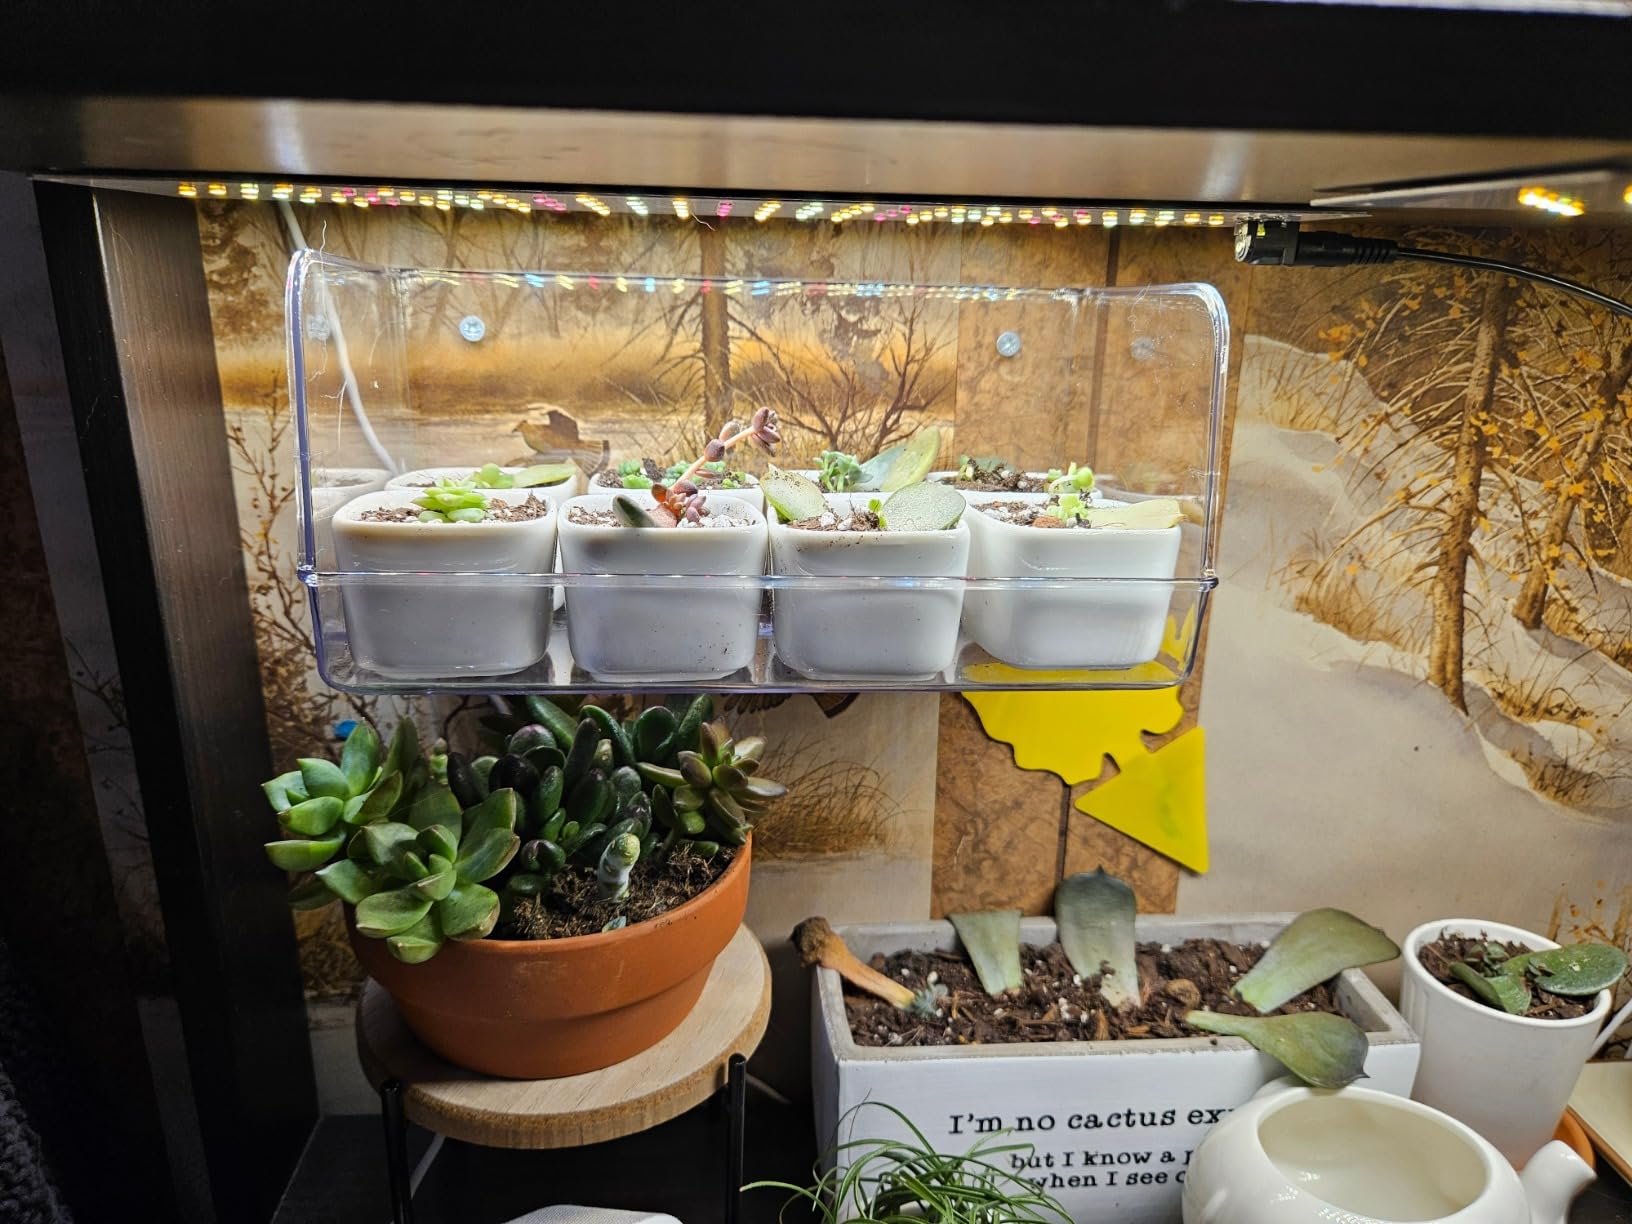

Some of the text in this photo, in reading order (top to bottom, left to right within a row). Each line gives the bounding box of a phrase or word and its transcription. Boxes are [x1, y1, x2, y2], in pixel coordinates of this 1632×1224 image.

[948, 1113, 1002, 1134] I'm
[1013, 1114, 1056, 1131] no
[1067, 1108, 1176, 1129] cactus
[1010, 1153, 1054, 1168] but
[1062, 1151, 1075, 1167] I
[1083, 1149, 1153, 1165] know
[1159, 1152, 1176, 1164] a
[1030, 1171, 1097, 1188] when
[1106, 1172, 1118, 1186] I
[1125, 1171, 1168, 1185] see
